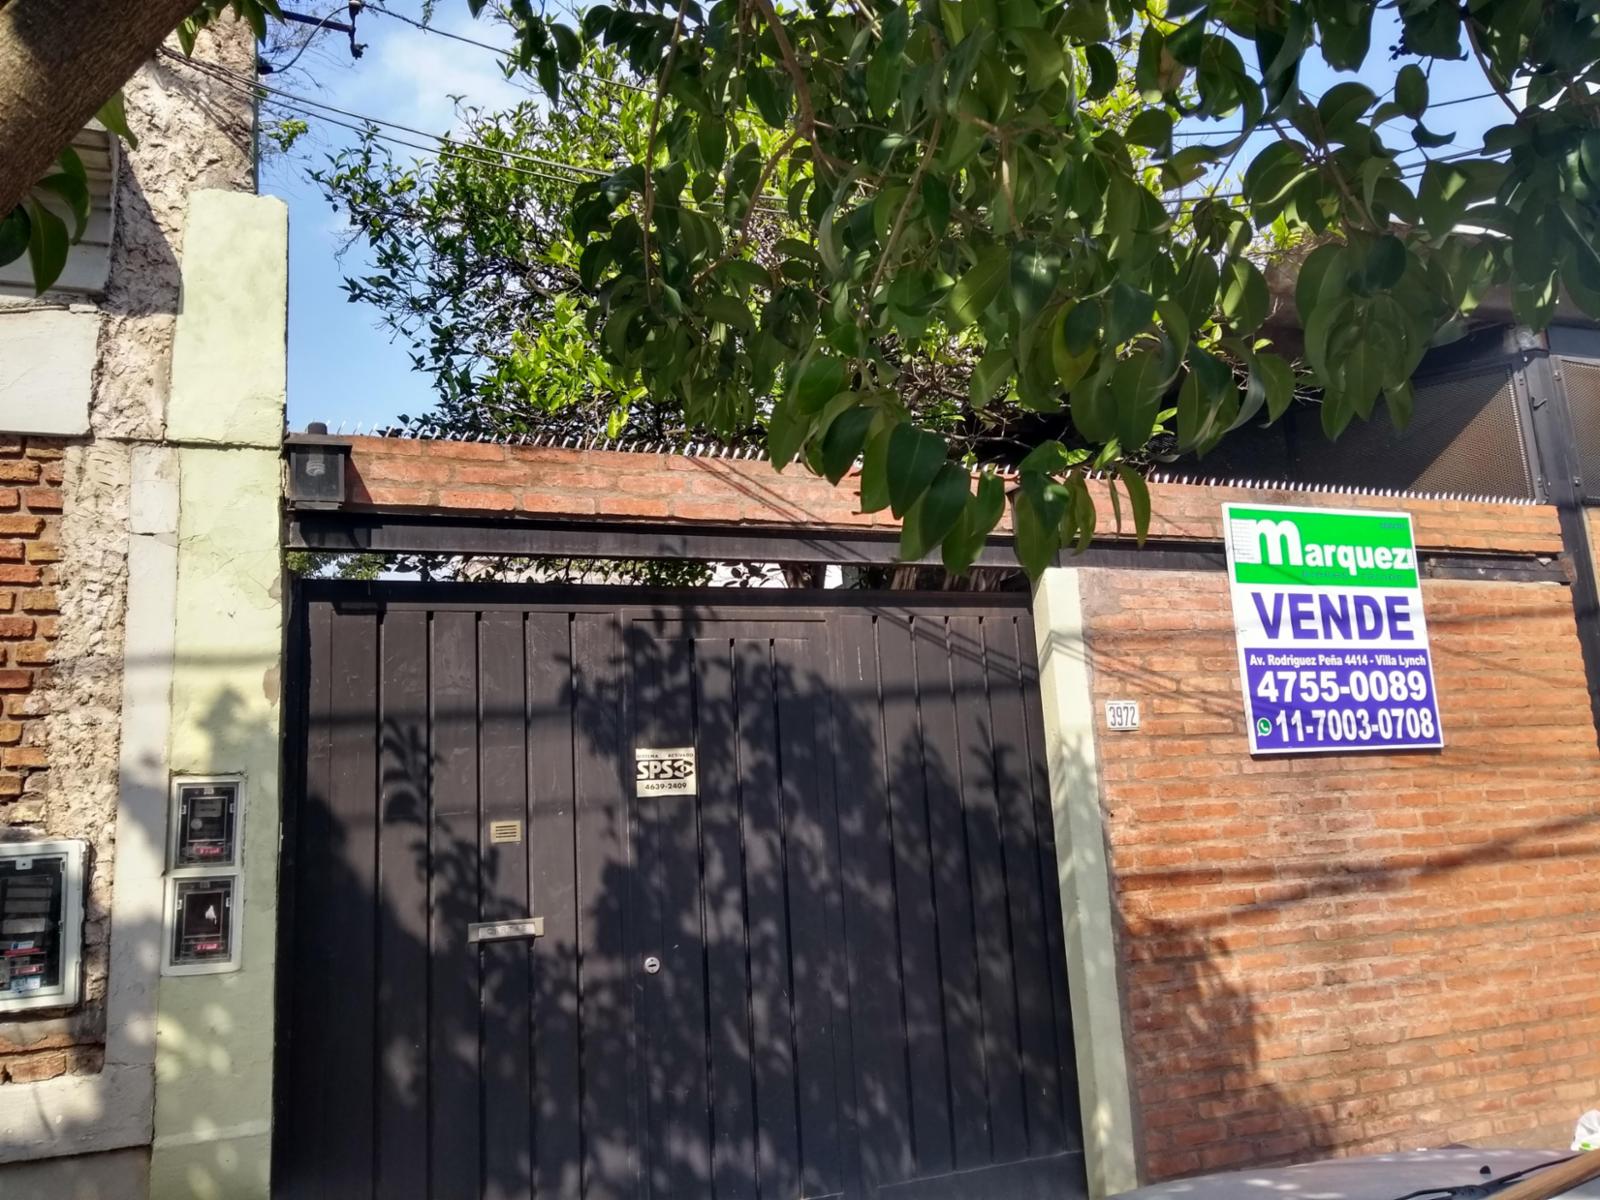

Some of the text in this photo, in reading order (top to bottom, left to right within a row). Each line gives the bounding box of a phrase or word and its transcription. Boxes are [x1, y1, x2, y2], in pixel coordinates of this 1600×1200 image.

[1251, 592, 1415, 640] VENDE
[1250, 654, 1266, 666] Av.
[1267, 654, 1317, 668] Rodriguez
[1318, 654, 1343, 666] Peña
[1344, 654, 1369, 666] 4414
[1375, 654, 1397, 666] Villa
[1398, 654, 1427, 669] Lynch
[1257, 670, 1428, 703] 4755-0089
[1108, 706, 1137, 727] 3972
[1276, 708, 1435, 742] 11-7003-0708
